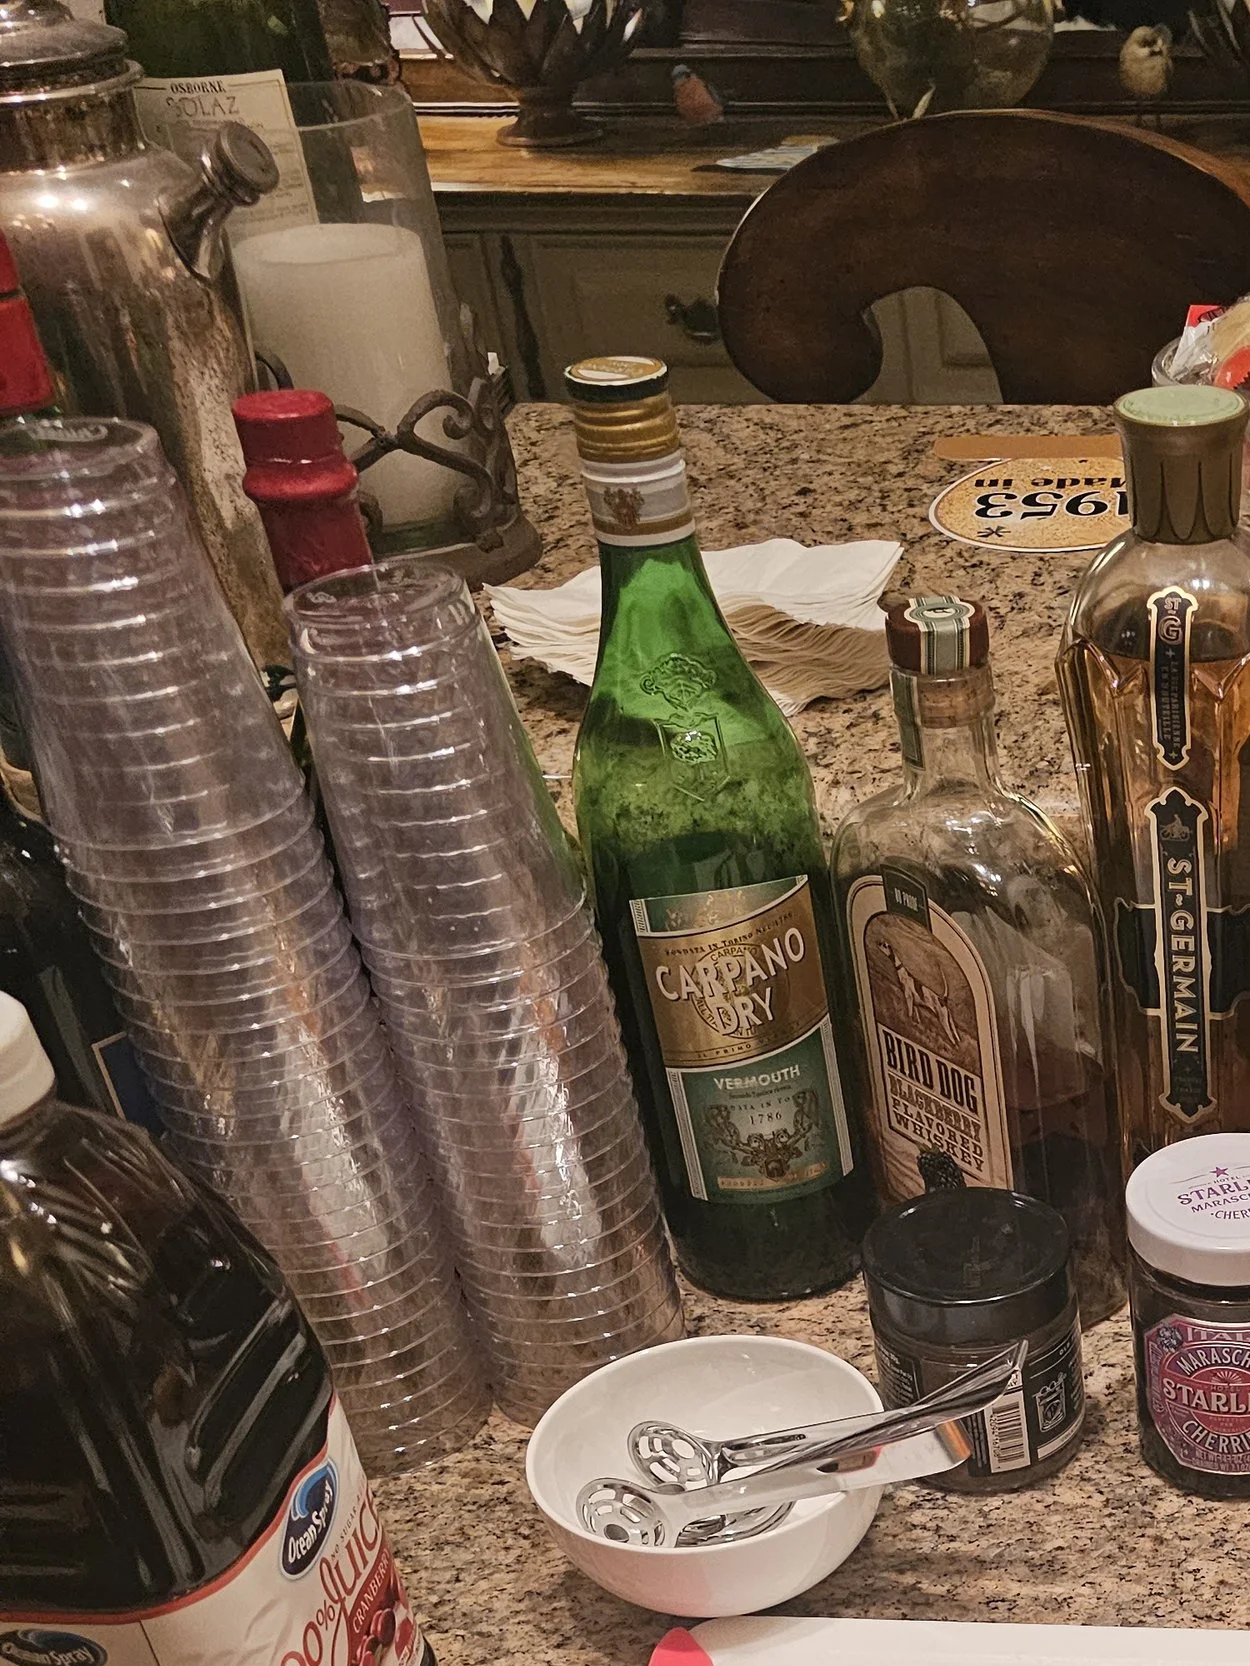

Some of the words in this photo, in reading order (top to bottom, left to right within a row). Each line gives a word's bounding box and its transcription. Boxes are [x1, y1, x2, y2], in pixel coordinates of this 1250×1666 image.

[170, 80, 228, 95] OSBORNE
[974, 478, 1014, 490] in
[974, 491, 1130, 521] 1953
[1163, 597, 1182, 611] ST
[1158, 615, 1183, 645] G
[655, 926, 806, 1001] CARPANO
[713, 986, 775, 1036] DRY
[713, 1064, 801, 1090] VERMOUTH
[882, 1029, 934, 1092] BIRD
[936, 1054, 979, 1117] DOG
[749, 1111, 783, 1126] 1786
[888, 1073, 982, 1142] BLACKBERRY
[891, 1096, 984, 1158] FLAVORED
[893, 1109, 985, 1173] WHISKEY
[1213, 1175, 1240, 1185] HOTEL
[288, 1528, 318, 1565] Ocean
[311, 1479, 334, 1534] Spray
